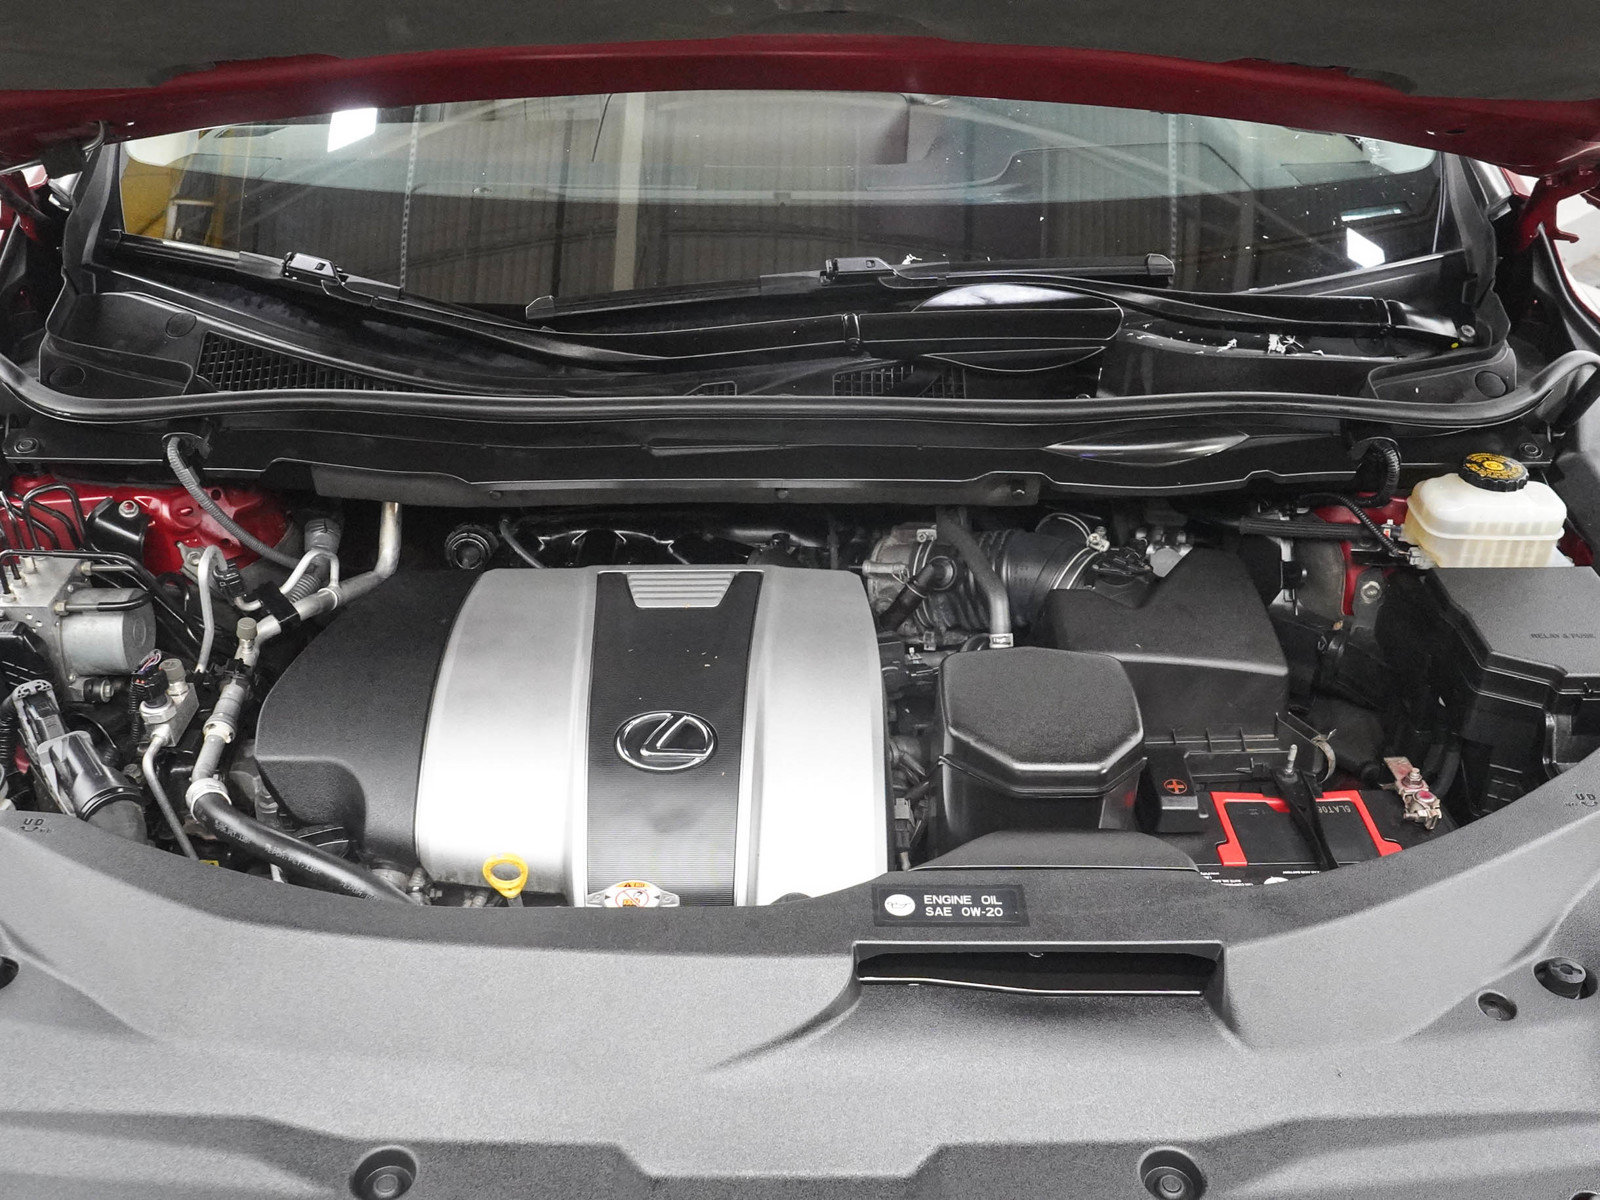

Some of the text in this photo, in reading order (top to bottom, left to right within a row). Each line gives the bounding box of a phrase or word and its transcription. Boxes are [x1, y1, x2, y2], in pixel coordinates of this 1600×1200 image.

[923, 894, 1003, 905] ENGINE OIL
[925, 906, 1004, 917] SAE 0W-20
